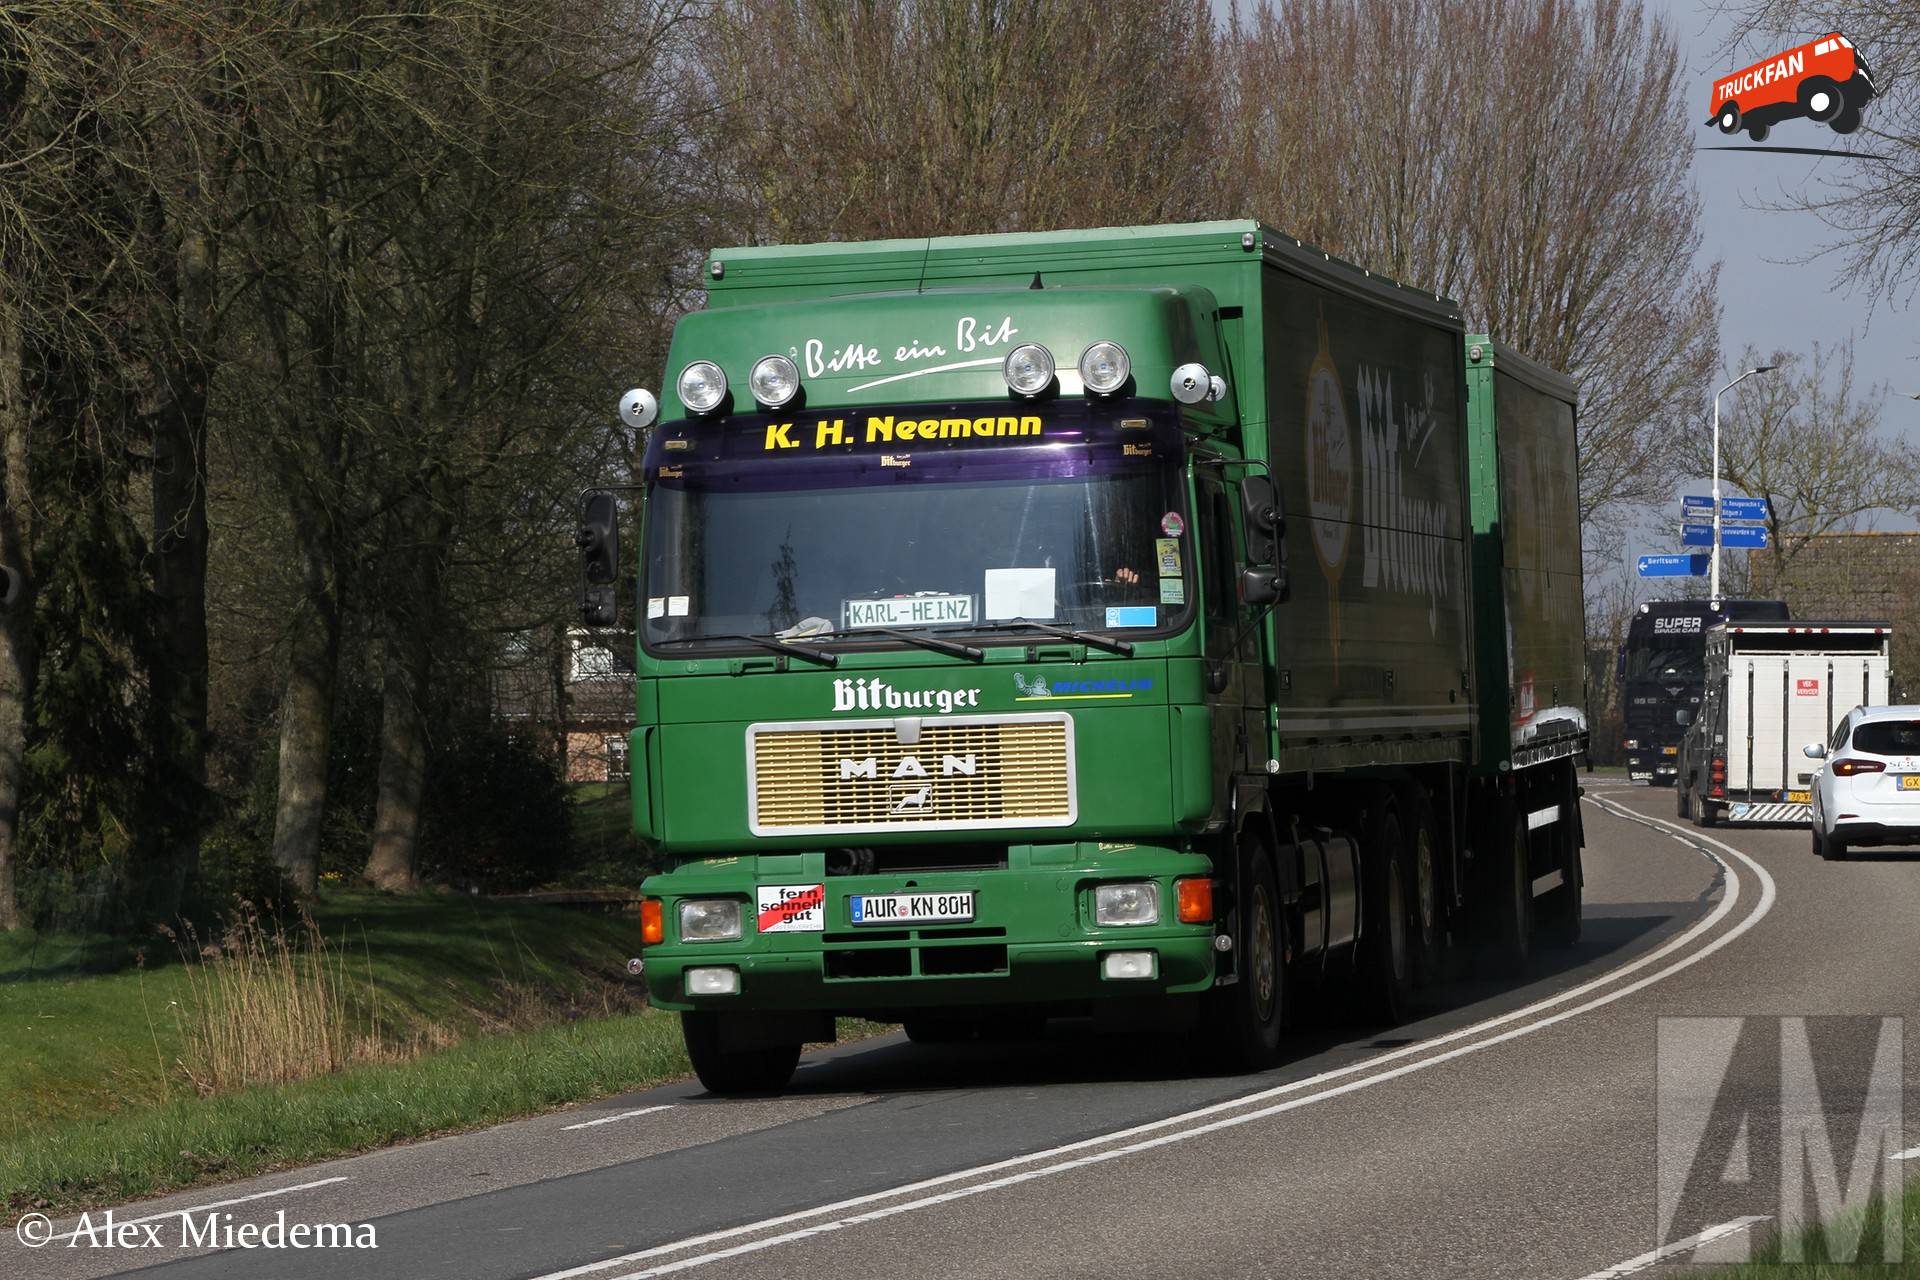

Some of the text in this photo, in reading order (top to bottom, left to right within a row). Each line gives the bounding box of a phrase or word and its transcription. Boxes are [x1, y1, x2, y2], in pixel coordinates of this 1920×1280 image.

[805, 316, 1018, 378] Bitte ein Bit
[764, 415, 1041, 449] K. H. Neemann
[852, 600, 969, 624] KARL-HEINZ
[1655, 617, 1701, 629] SUPER
[831, 677, 981, 713] Bitburger
[840, 754, 976, 780] MAN
[761, 899, 821, 911] schnell
[779, 888, 818, 899] fern
[782, 910, 812, 924] gut
[864, 895, 971, 918] AUR KN 80H
